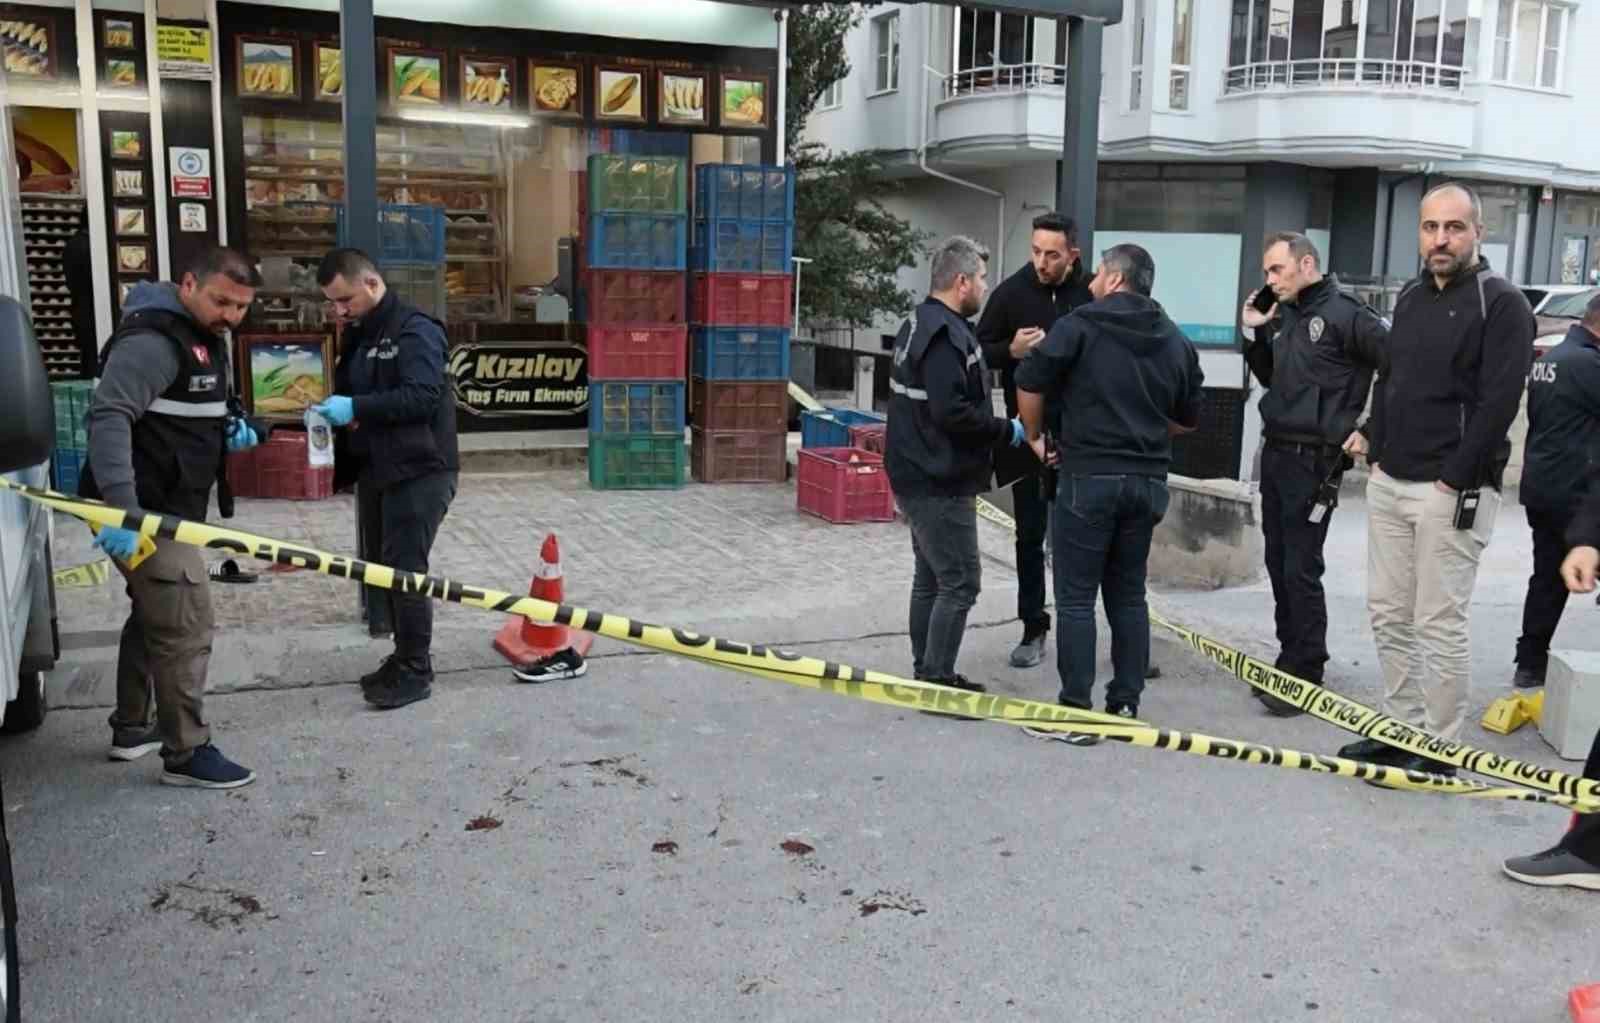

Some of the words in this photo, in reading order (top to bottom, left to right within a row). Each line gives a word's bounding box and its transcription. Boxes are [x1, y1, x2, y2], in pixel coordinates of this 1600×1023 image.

[475, 353, 583, 382] Kızılay
[467, 389, 491, 405] Taş
[495, 388, 531, 403] Fırın
[534, 386, 588, 404] Ekmeği
